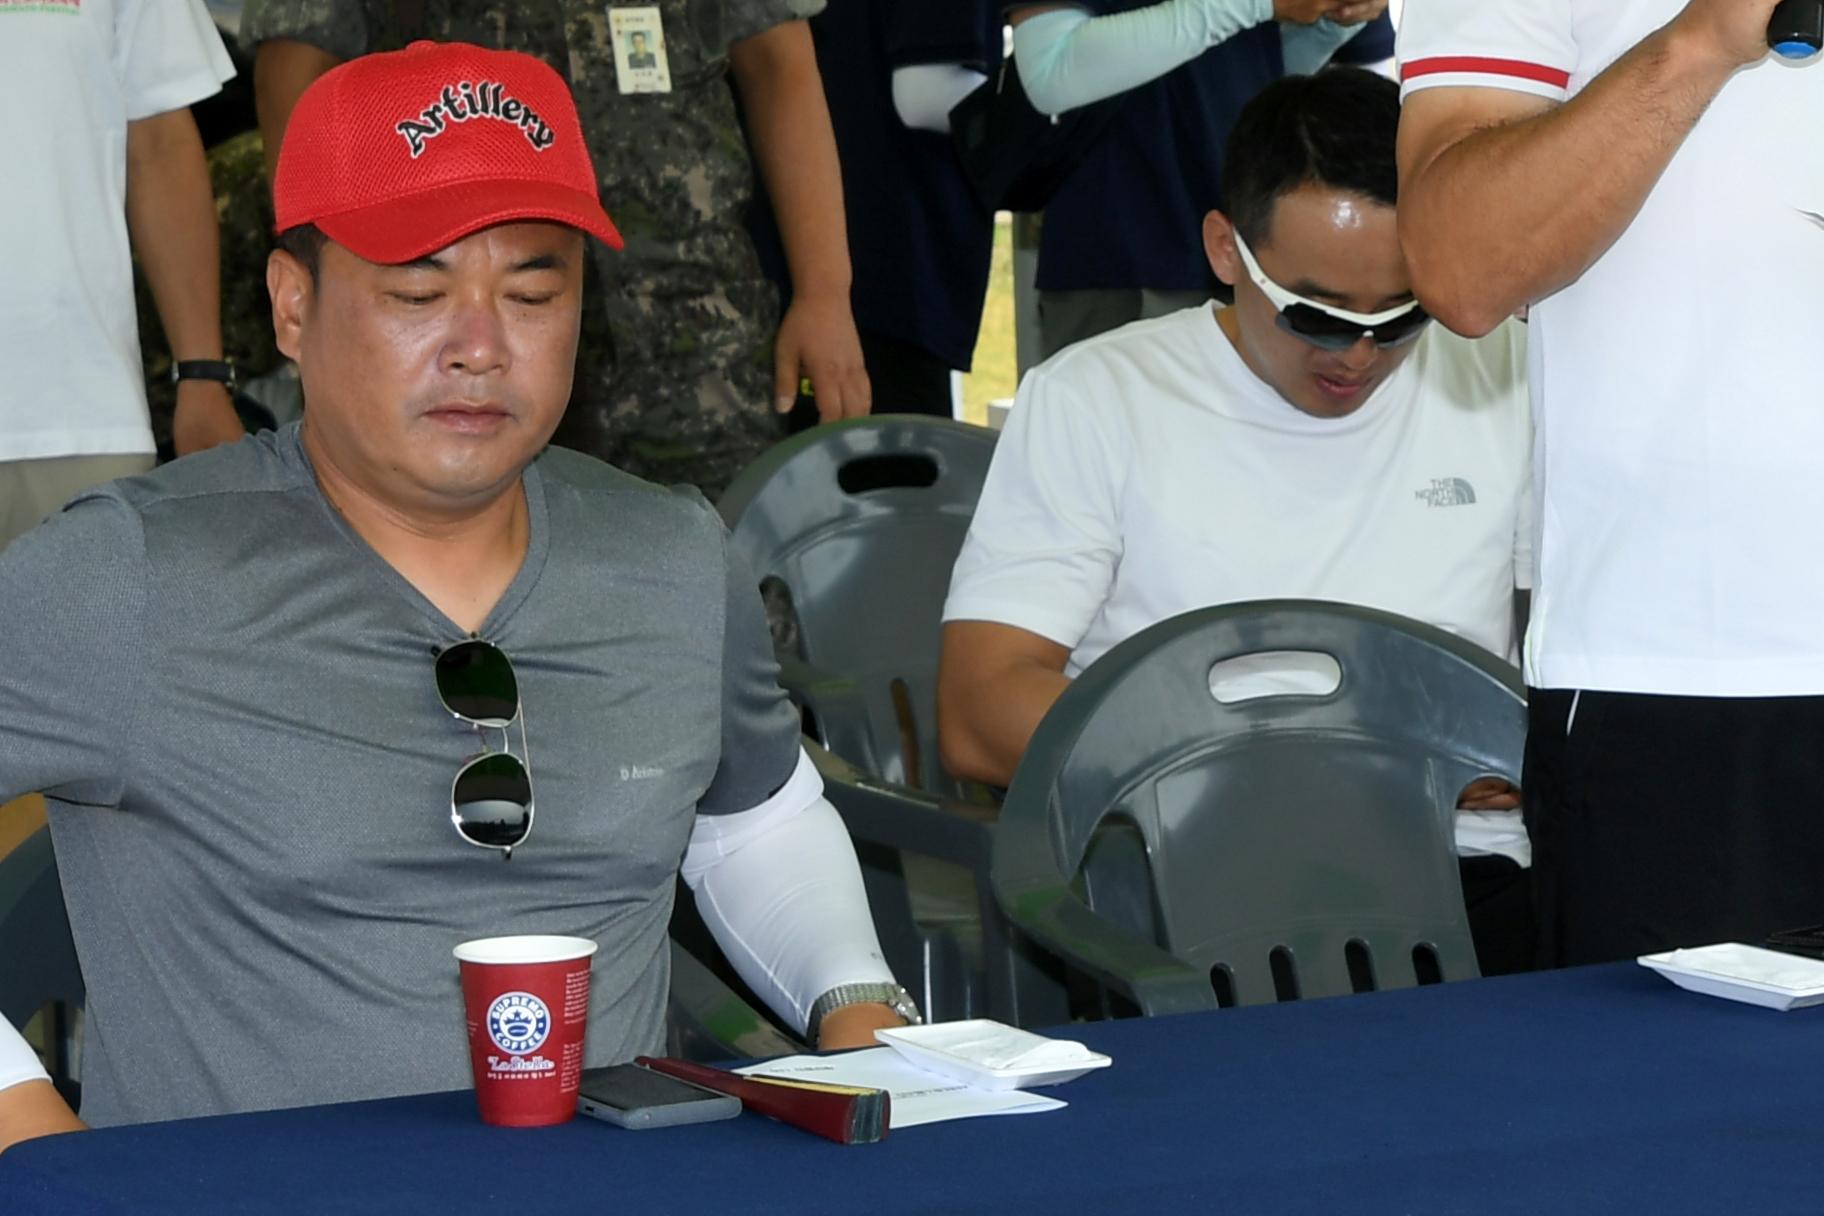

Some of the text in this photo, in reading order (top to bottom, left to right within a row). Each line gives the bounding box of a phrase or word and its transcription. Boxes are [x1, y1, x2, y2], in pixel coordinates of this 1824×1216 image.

[396, 80, 555, 158] Artillery
[1430, 478, 1453, 488] THE
[1415, 486, 1455, 500] NORTH
[1427, 496, 1455, 508] FACE
[491, 996, 544, 1019] SUPREMO
[495, 1031, 543, 1050] COFFEE
